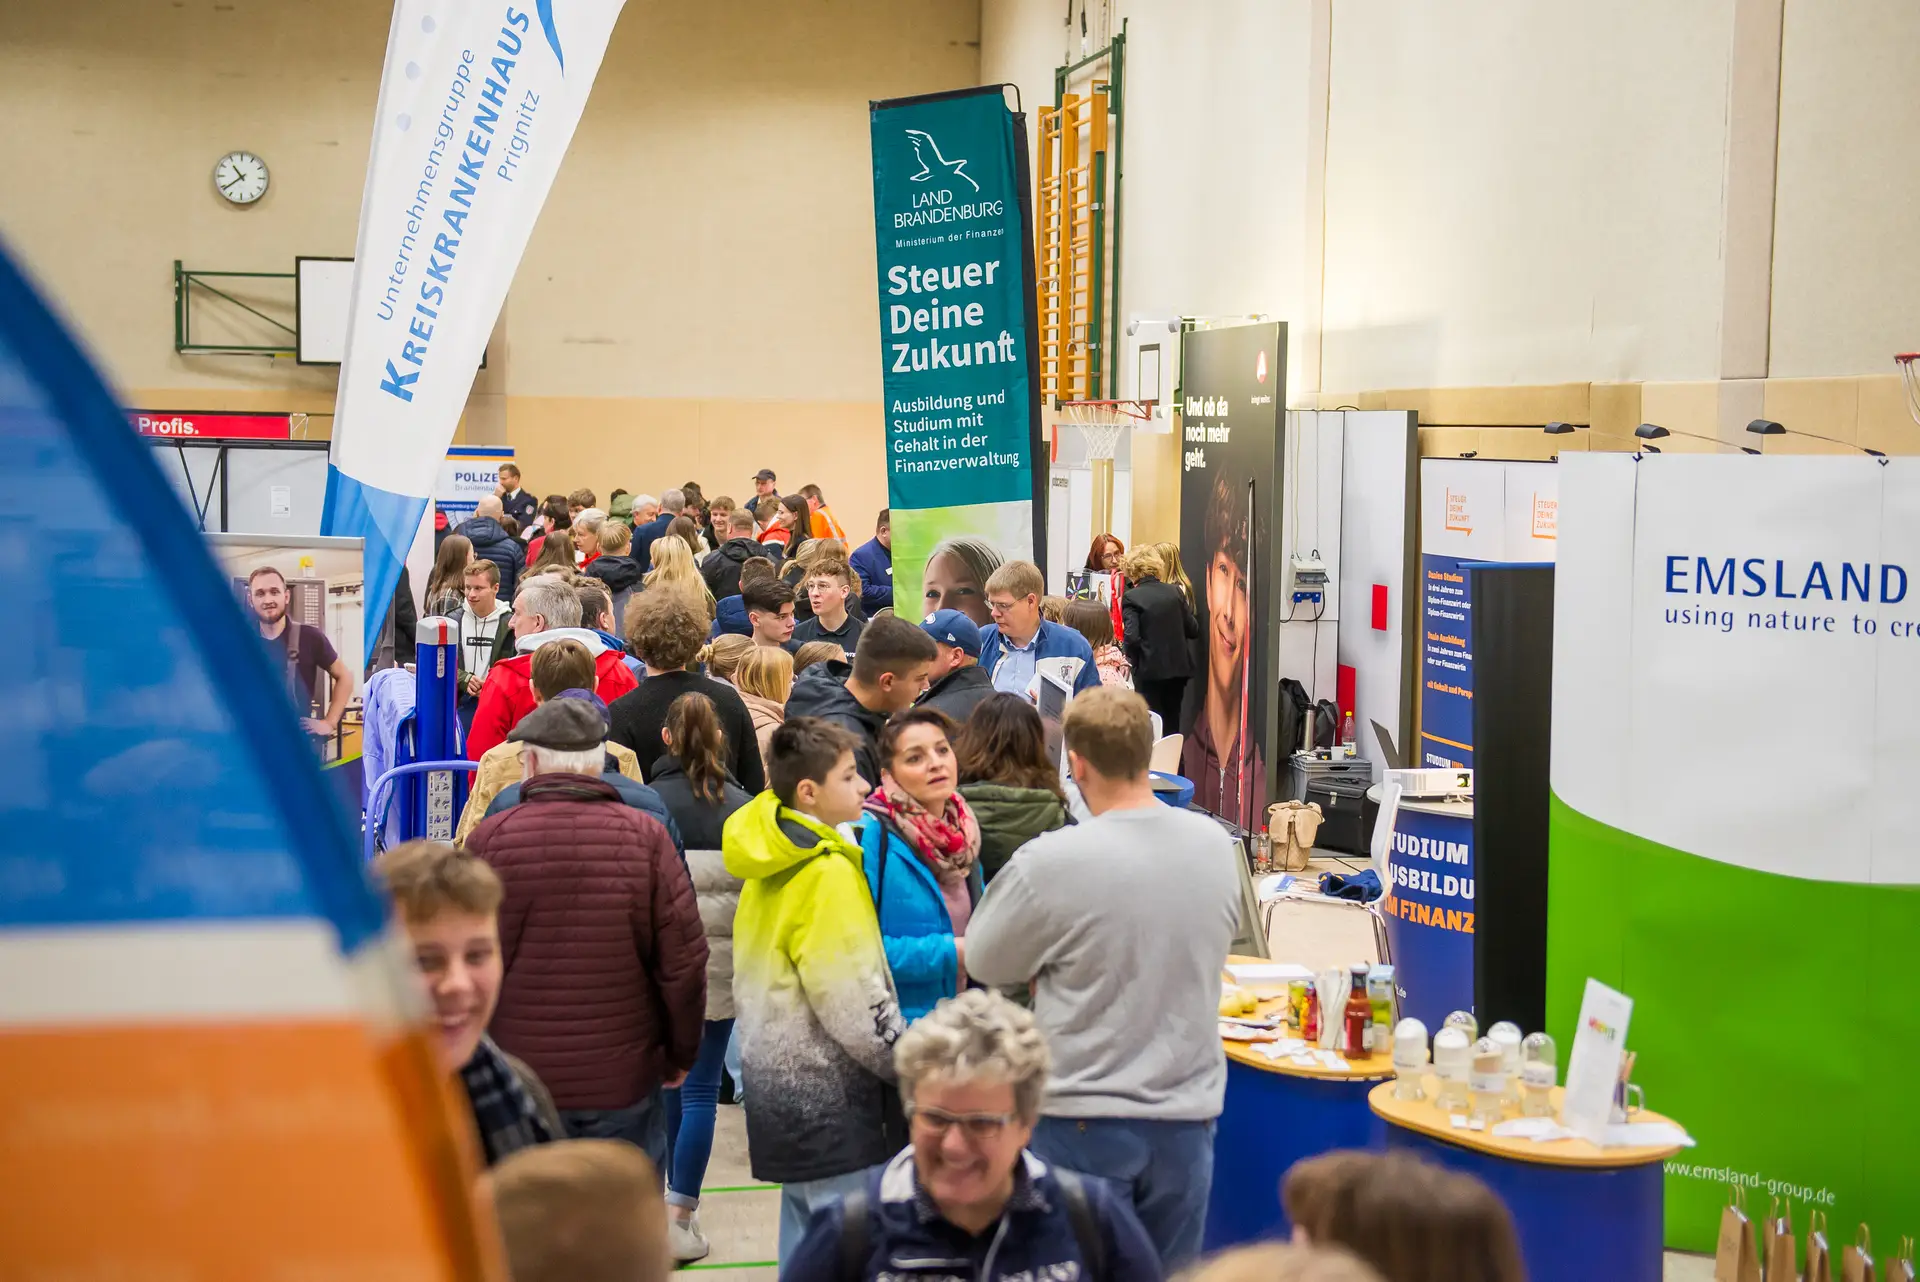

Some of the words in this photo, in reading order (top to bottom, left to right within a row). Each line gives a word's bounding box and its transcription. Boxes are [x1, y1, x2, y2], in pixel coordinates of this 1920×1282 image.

[497, 89, 540, 182] Prignitz
[377, 49, 474, 320] Unternehmensgruppe
[380, 7, 529, 402] KREISKRANKENHAUS
[912, 189, 953, 209] LAND
[894, 200, 1003, 228] BRANDENBURG
[895, 235, 945, 248] Ministerium
[947, 233, 963, 242] der
[888, 260, 1000, 296] Steuer
[890, 298, 984, 334] Deine
[891, 330, 1017, 373] Zukunft
[892, 394, 973, 413] Ausbildung
[976, 389, 1005, 406] und
[1186, 396, 1203, 416] Und
[1204, 396, 1215, 417] ob
[1216, 395, 1229, 416] da
[138, 417, 199, 434] Profis.
[893, 416, 953, 433] Studium
[956, 412, 984, 428] mit
[1185, 422, 1206, 442] noch
[1207, 422, 1231, 443] mehr
[894, 436, 940, 453] Gehalt
[943, 435, 957, 450] in
[961, 433, 988, 448] der
[895, 451, 1020, 473] Finanzverwaltung
[1185, 447, 1206, 472] geht.
[455, 472, 499, 482] POLIZE
[1665, 555, 1908, 604] EMSLAND
[1665, 604, 1734, 633] using
[1748, 610, 1836, 632] nature
[1853, 614, 1877, 634] to
[1391, 831, 1469, 865] TUDIUM
[1390, 862, 1475, 900] USBILDU
[1400, 899, 1475, 934] FINANZ
